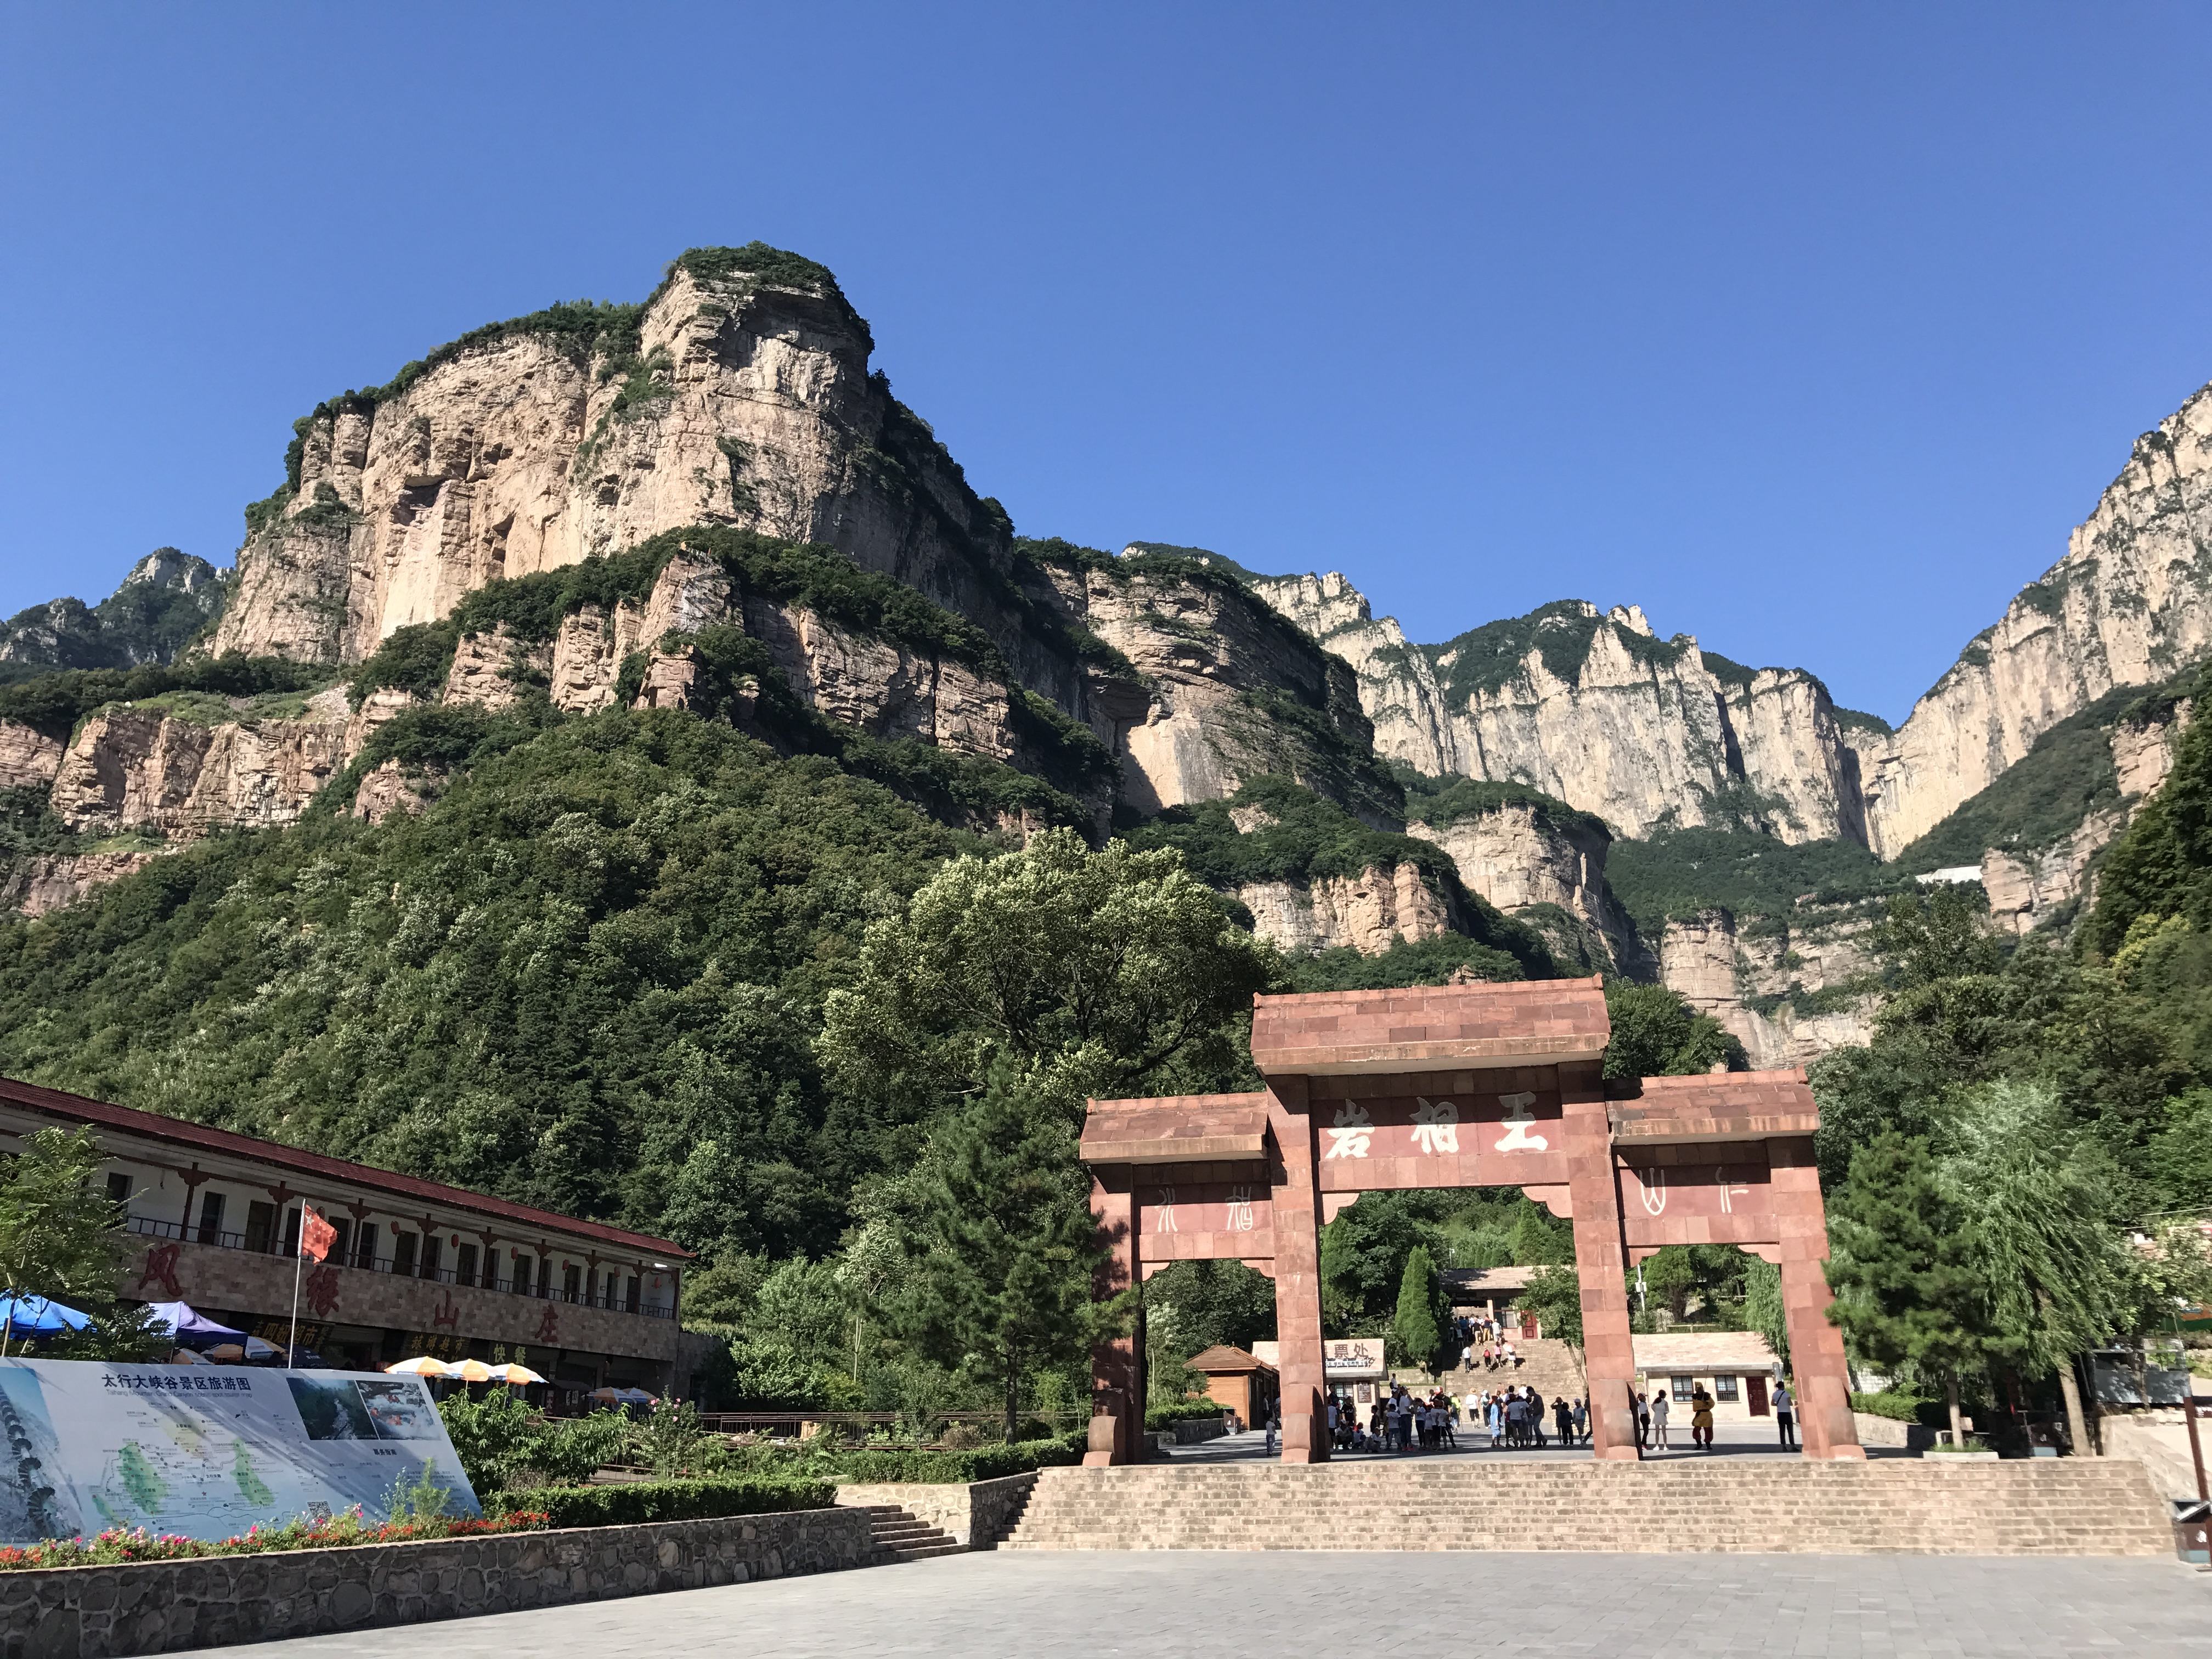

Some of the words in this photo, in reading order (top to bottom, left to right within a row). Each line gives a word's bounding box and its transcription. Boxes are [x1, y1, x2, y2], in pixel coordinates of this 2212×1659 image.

[494, 1344, 526, 1365] 快餐
[1324, 1342, 1369, 1358] 票处
[101, 1374, 251, 1391] 太行大峡谷景区旅游图
